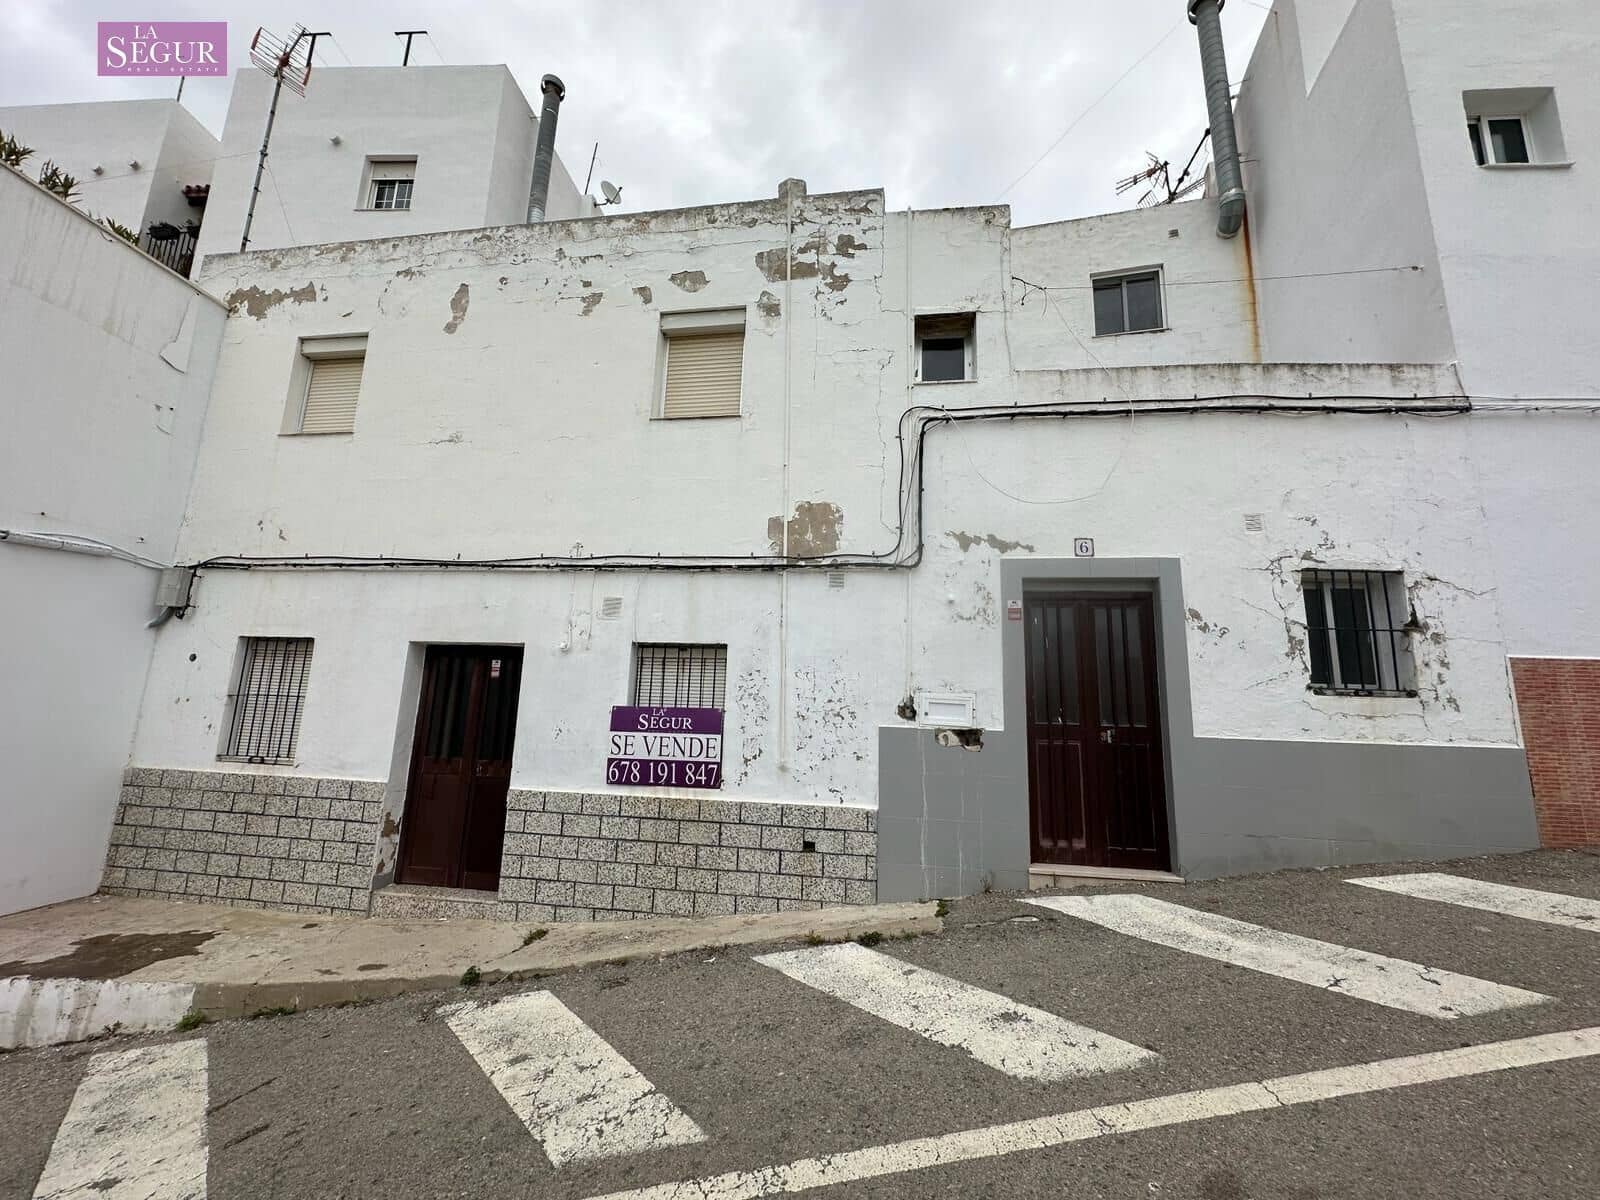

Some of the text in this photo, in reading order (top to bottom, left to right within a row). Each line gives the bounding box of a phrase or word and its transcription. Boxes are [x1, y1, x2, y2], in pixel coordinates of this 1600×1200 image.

[1080, 541, 1088, 553] 6
[652, 708, 665, 716] LA
[637, 713, 693, 730] SEGUR
[610, 734, 718, 759] SE VENDE
[608, 760, 718, 786] 678 191 847
